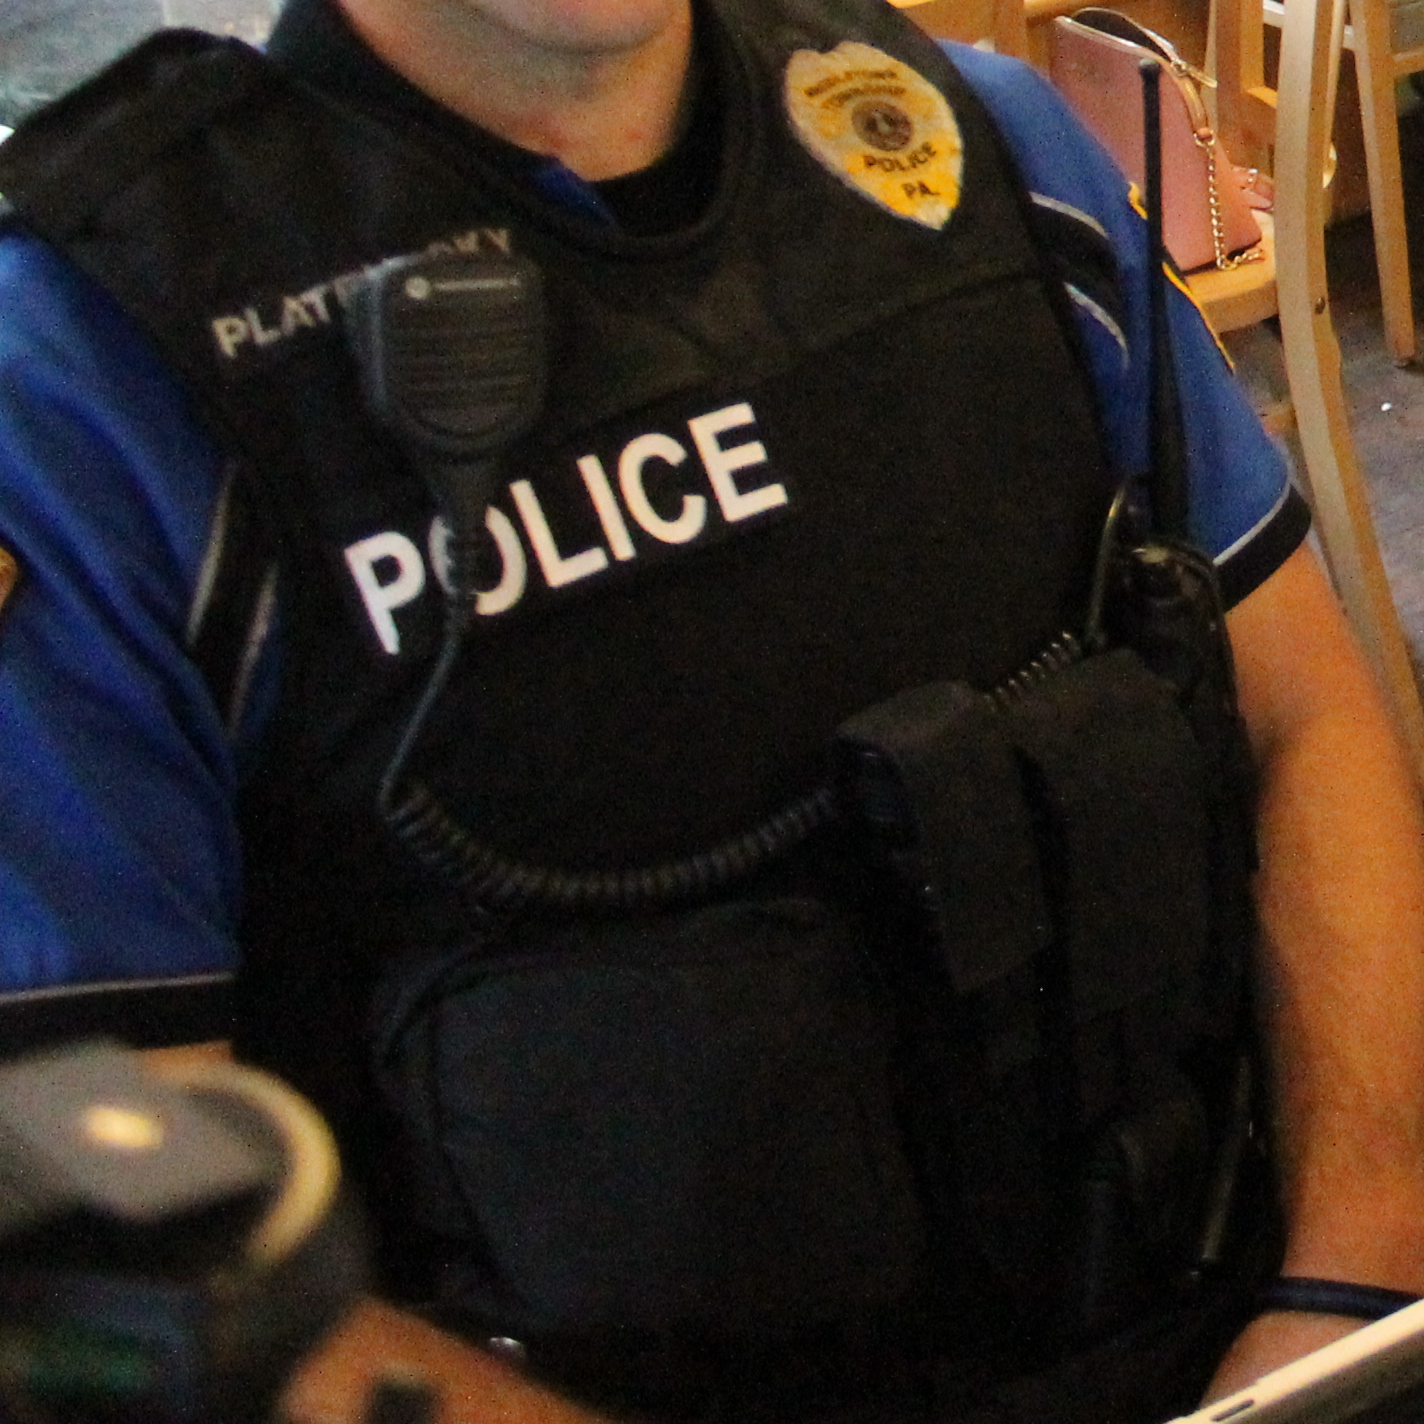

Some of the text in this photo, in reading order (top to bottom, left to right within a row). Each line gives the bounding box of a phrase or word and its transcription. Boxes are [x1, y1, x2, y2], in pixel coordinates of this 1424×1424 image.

[863, 140, 938, 173] POLICE
[902, 180, 941, 200] PA
[343, 401, 789, 656] POLICE
